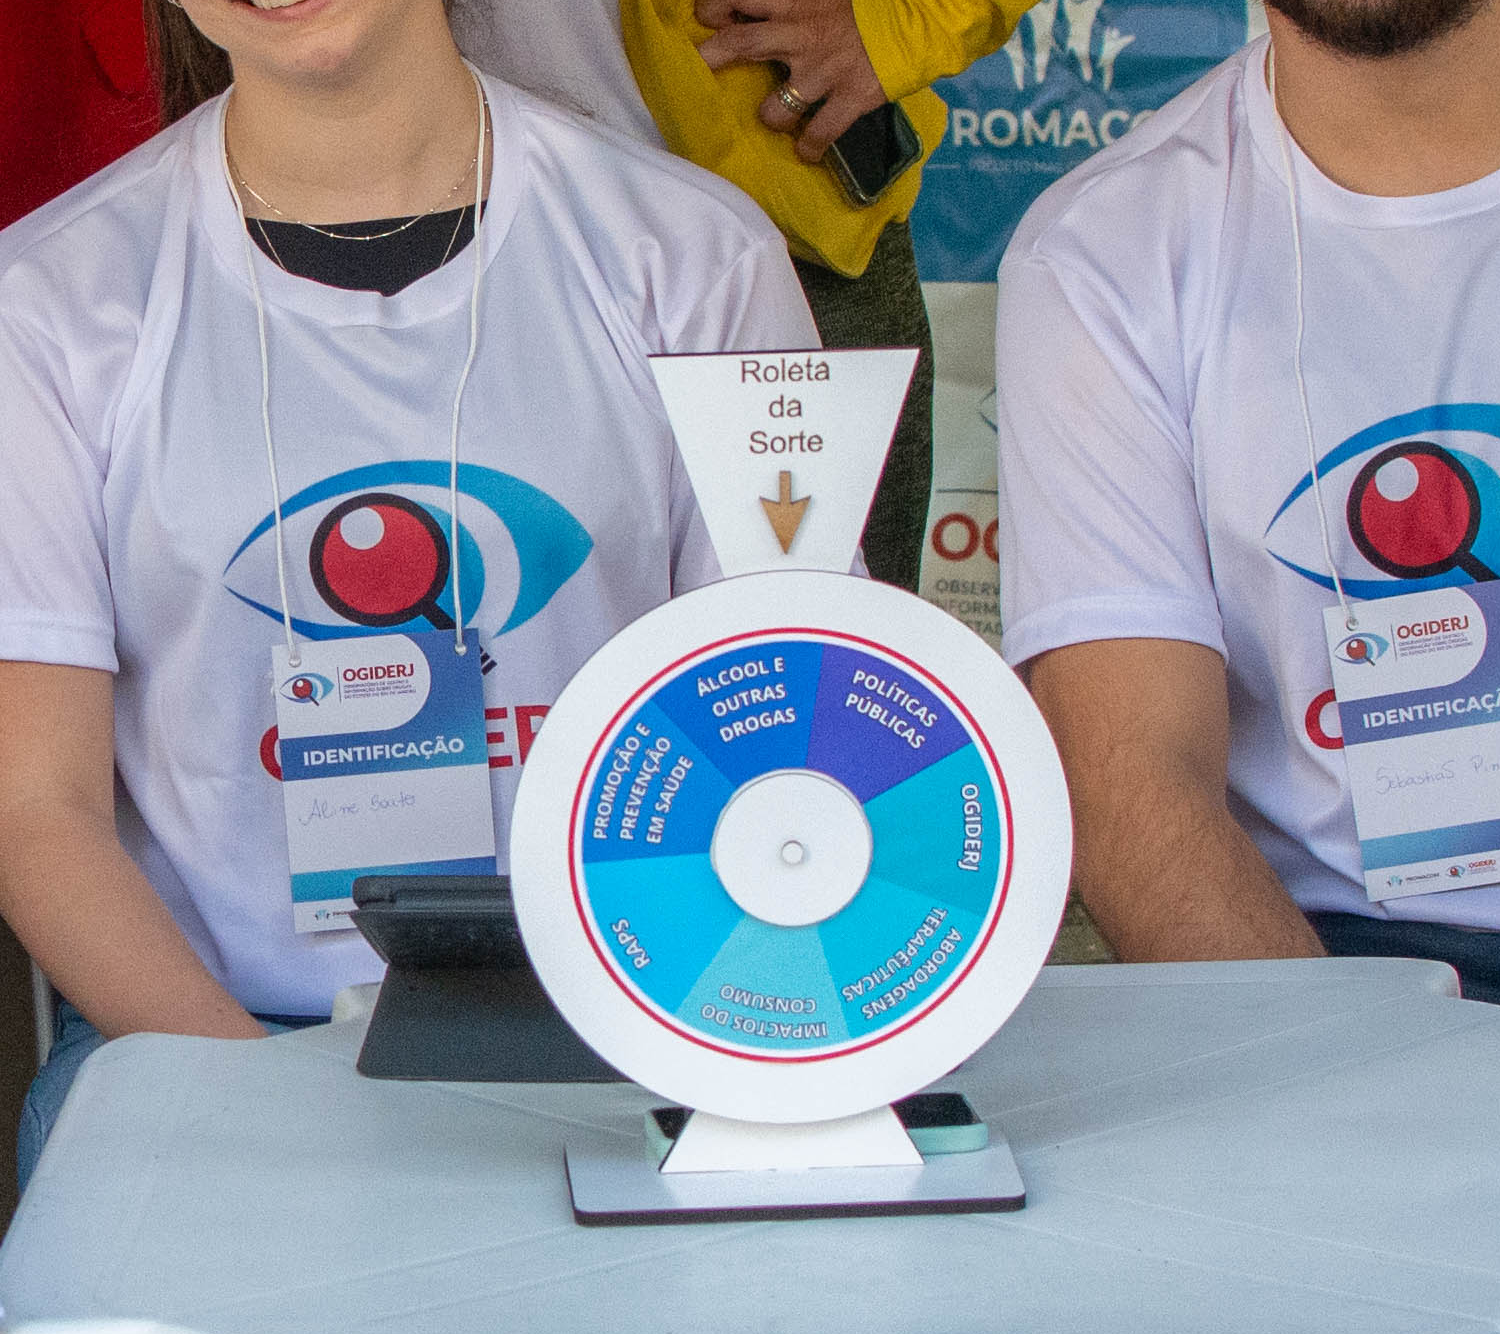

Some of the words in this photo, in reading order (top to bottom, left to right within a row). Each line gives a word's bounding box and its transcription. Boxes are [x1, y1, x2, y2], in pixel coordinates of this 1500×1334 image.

[952, 108, 1158, 148] ROMAC
[740, 356, 831, 384] Roleta
[768, 393, 803, 419] da
[748, 427, 824, 456] Sorte
[1397, 615, 1469, 639] OGIDERJ
[343, 663, 414, 682] OGIDERJ
[696, 659, 770, 697] ÁLCOOL
[774, 656, 785, 673] E
[712, 683, 786, 718] OUTRAS
[852, 669, 938, 728] POLÍTICAS
[719, 707, 796, 743] DROGAS
[845, 692, 925, 749] PÚBLICAS
[303, 736, 465, 767] IDENTIFICAÇÃO
[593, 736, 641, 839] PROMOÇÃO
[635, 722, 651, 737] E
[619, 737, 671, 840] PREVENÇÃO
[655, 755, 693, 814] SAÚDE
[646, 816, 665, 844] EM
[958, 783, 982, 871] OGIDERJ
[612, 918, 652, 971] RAPS
[842, 907, 949, 1002] TERAPÊUTICAS
[862, 927, 963, 1020] ABORDAGENS
[701, 1003, 730, 1026] DO
[719, 984, 817, 1014] CONSUMO
[733, 1015, 828, 1039] IMPACTOS
